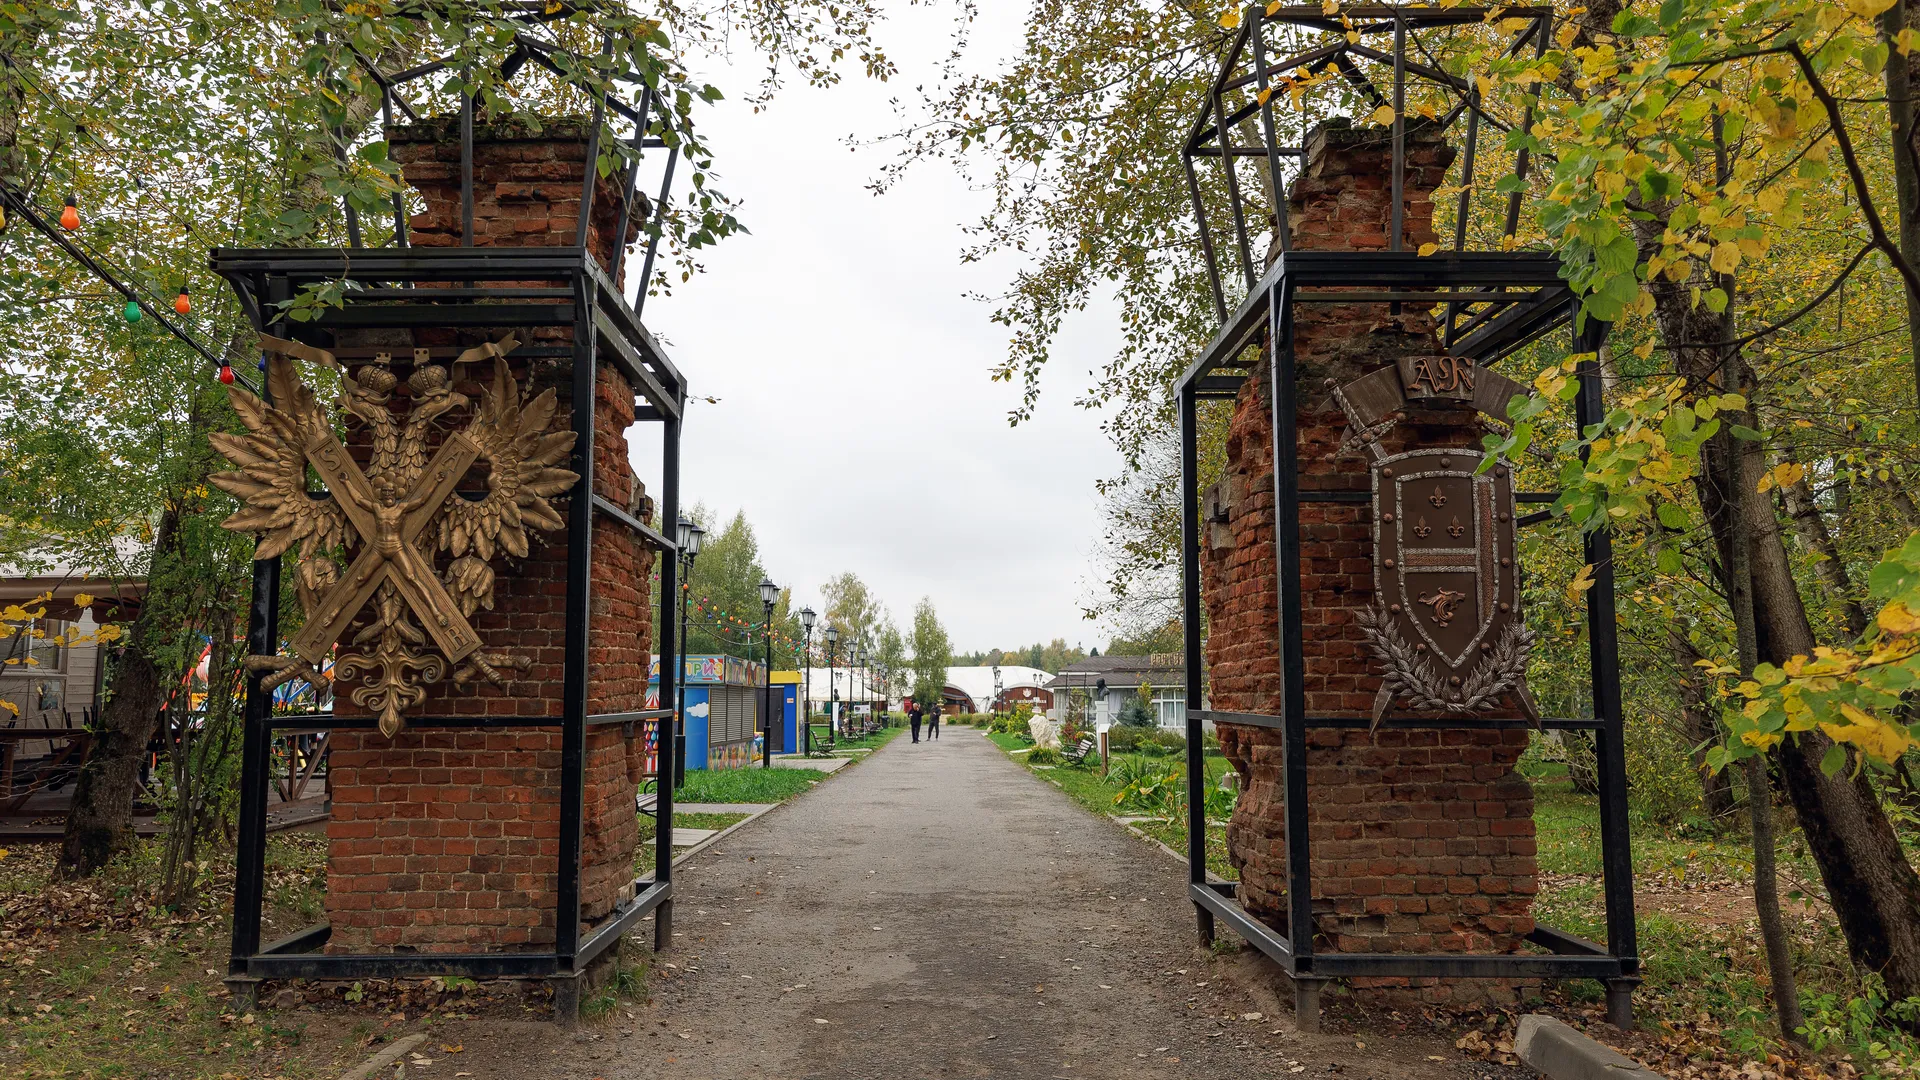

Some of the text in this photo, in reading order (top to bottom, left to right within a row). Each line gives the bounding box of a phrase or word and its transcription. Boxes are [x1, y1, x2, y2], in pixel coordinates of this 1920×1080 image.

[318, 448, 342, 471] S
[441, 449, 465, 472] A
[308, 626, 327, 649] P
[443, 627, 470, 651] R
